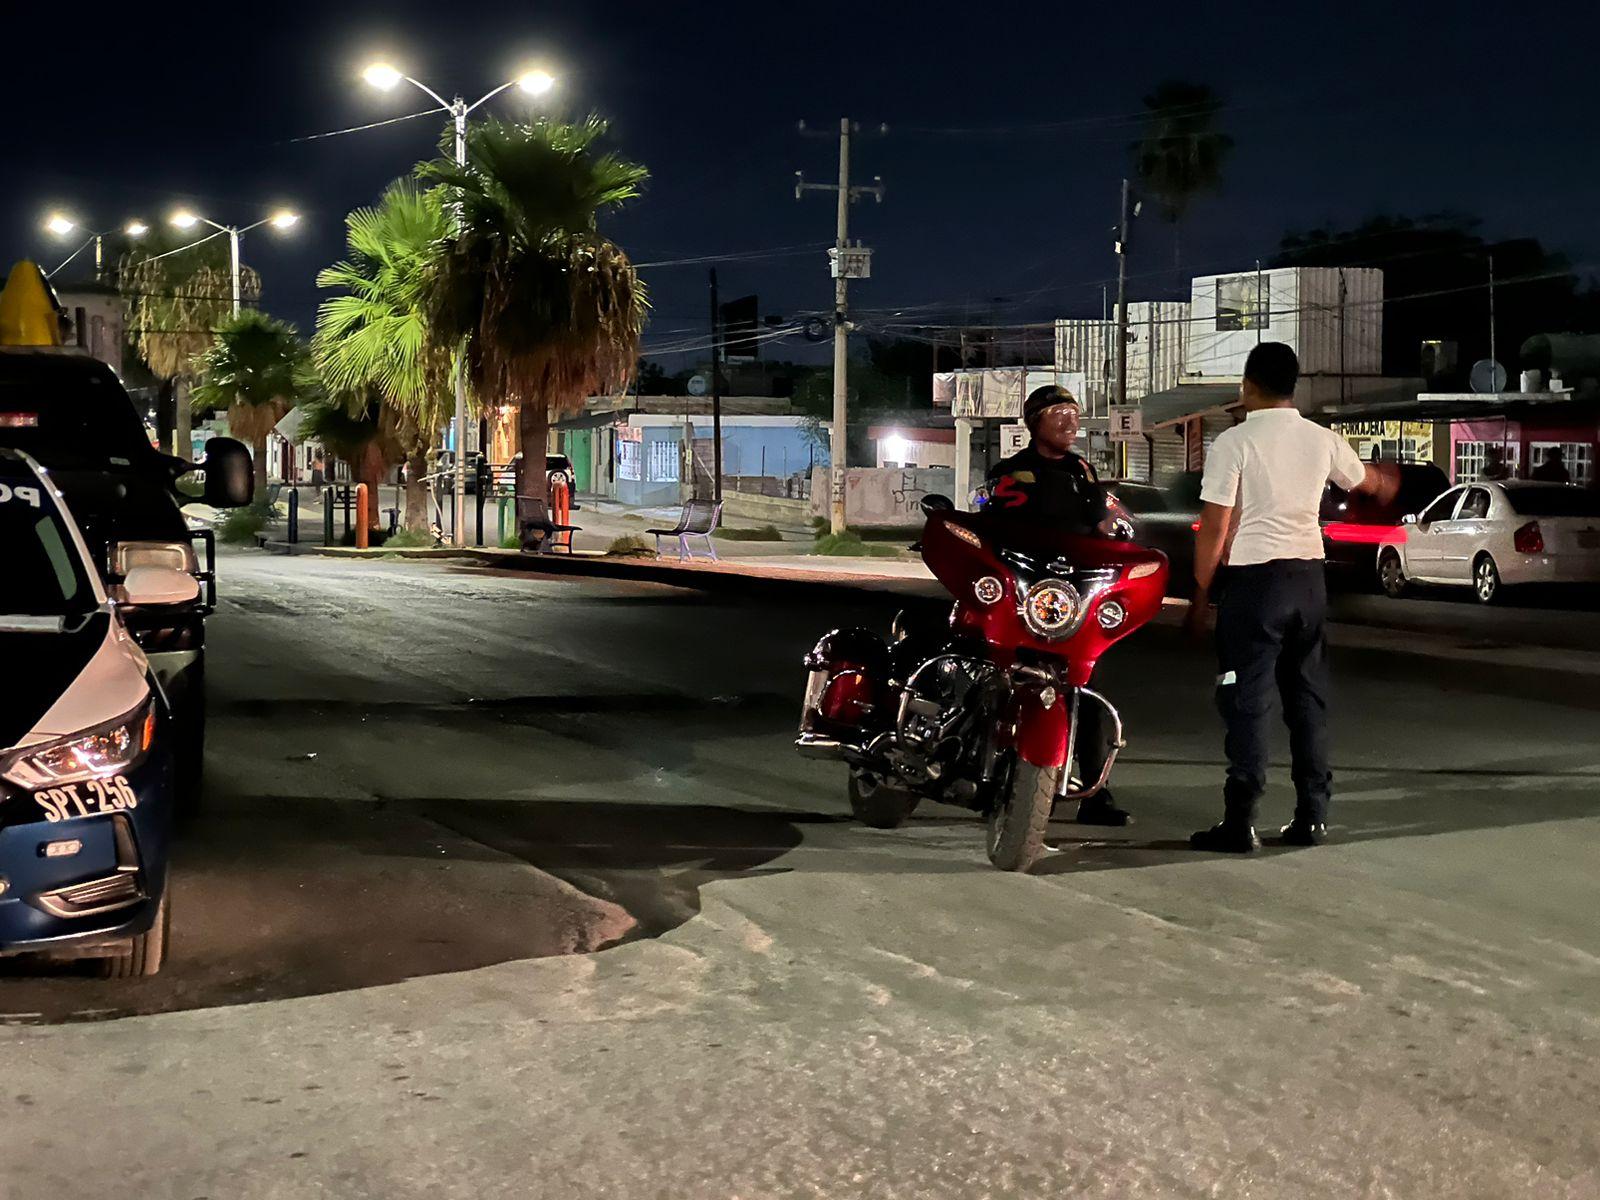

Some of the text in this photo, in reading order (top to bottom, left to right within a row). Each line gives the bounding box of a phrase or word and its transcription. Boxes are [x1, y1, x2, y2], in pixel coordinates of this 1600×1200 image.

[1121, 416, 1131, 430] E
[1012, 435, 1022, 448] E
[34, 775, 138, 823] SPT-256
